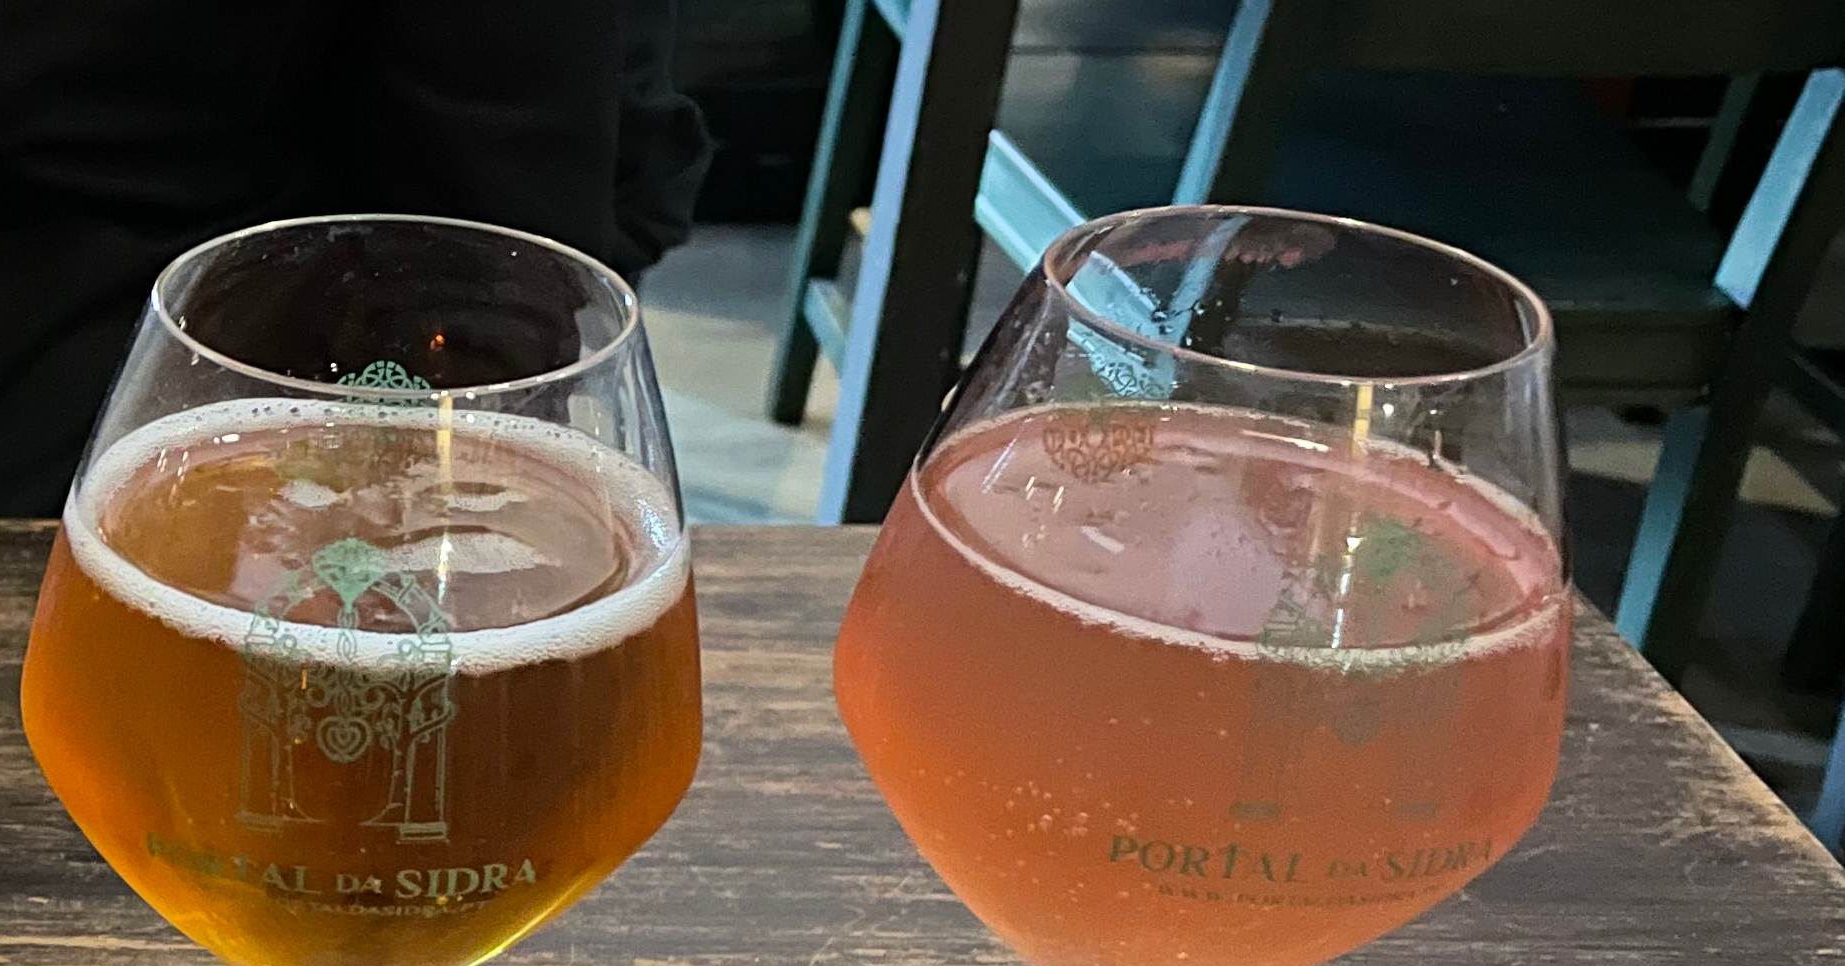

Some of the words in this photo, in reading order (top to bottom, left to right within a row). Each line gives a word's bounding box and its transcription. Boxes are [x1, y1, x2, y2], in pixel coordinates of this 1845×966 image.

[336, 872, 383, 895] DA
[395, 857, 538, 900] SIDRA
[1108, 833, 1310, 884] PORTAL
